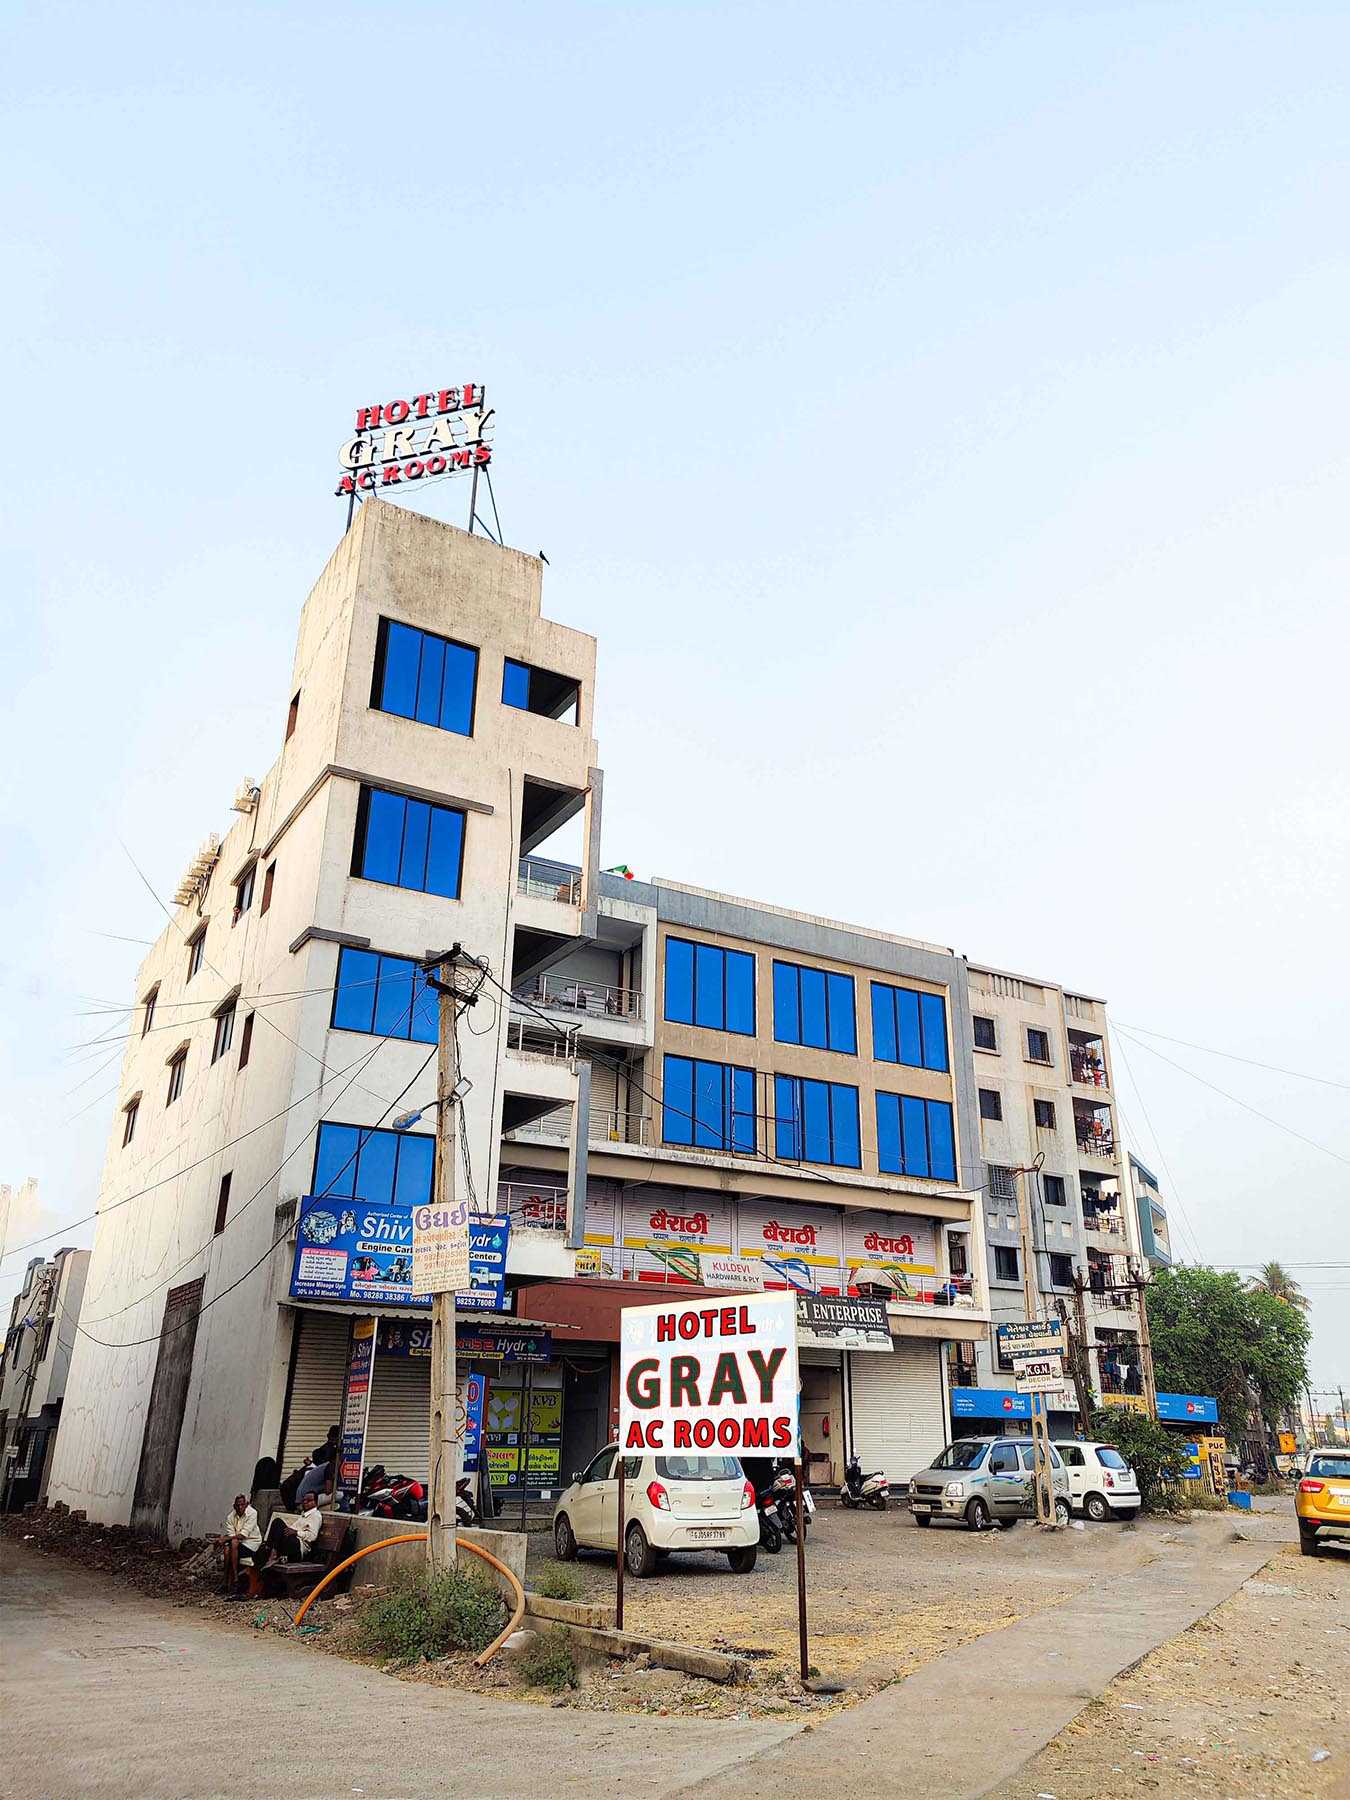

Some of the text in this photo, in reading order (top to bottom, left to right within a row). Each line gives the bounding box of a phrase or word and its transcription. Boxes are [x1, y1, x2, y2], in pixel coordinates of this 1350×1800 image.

[355, 383, 485, 434] HOTEL
[338, 409, 494, 470] GRAY
[335, 446, 492, 496] AC ROOMS
[361, 1216, 411, 1240] Shiv
[649, 1208, 709, 1234] बैराठी
[763, 1220, 817, 1245] बैराठी
[361, 1244, 392, 1254] Engine
[469, 1233, 491, 1250] ydr
[864, 1232, 914, 1257] बैराठी
[706, 1273, 742, 1282] HARDWARE
[713, 1262, 751, 1273] KULDEVI
[350, 1290, 361, 1298] Mo.
[657, 1306, 756, 1342] HOTEL
[813, 1303, 884, 1324] ENTERPRISE
[497, 1338, 526, 1354] Hydr
[626, 1347, 787, 1410] GRAY
[1026, 1365, 1050, 1376] K.G.N.
[531, 1395, 557, 1407] KVB
[626, 1417, 792, 1448] AC ROOMS
